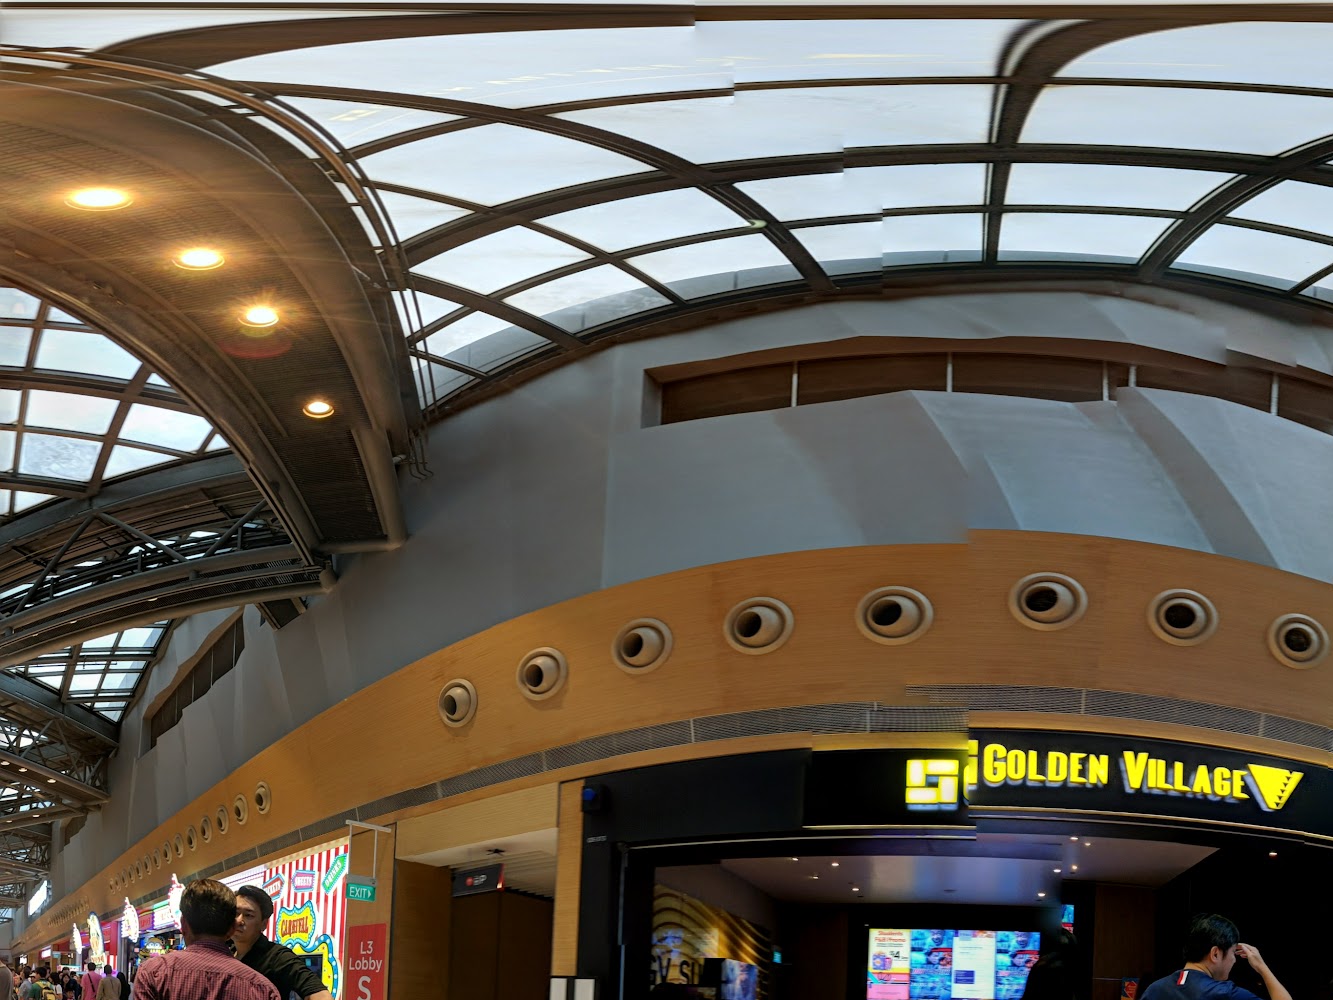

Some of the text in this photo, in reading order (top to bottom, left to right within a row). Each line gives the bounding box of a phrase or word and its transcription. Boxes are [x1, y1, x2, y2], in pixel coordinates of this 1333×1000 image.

[983, 743, 1251, 800] GOLDEN VILLAGE
[350, 886, 367, 899] EXIT
[360, 940, 374, 955] L3
[349, 957, 383, 973] Lobby
